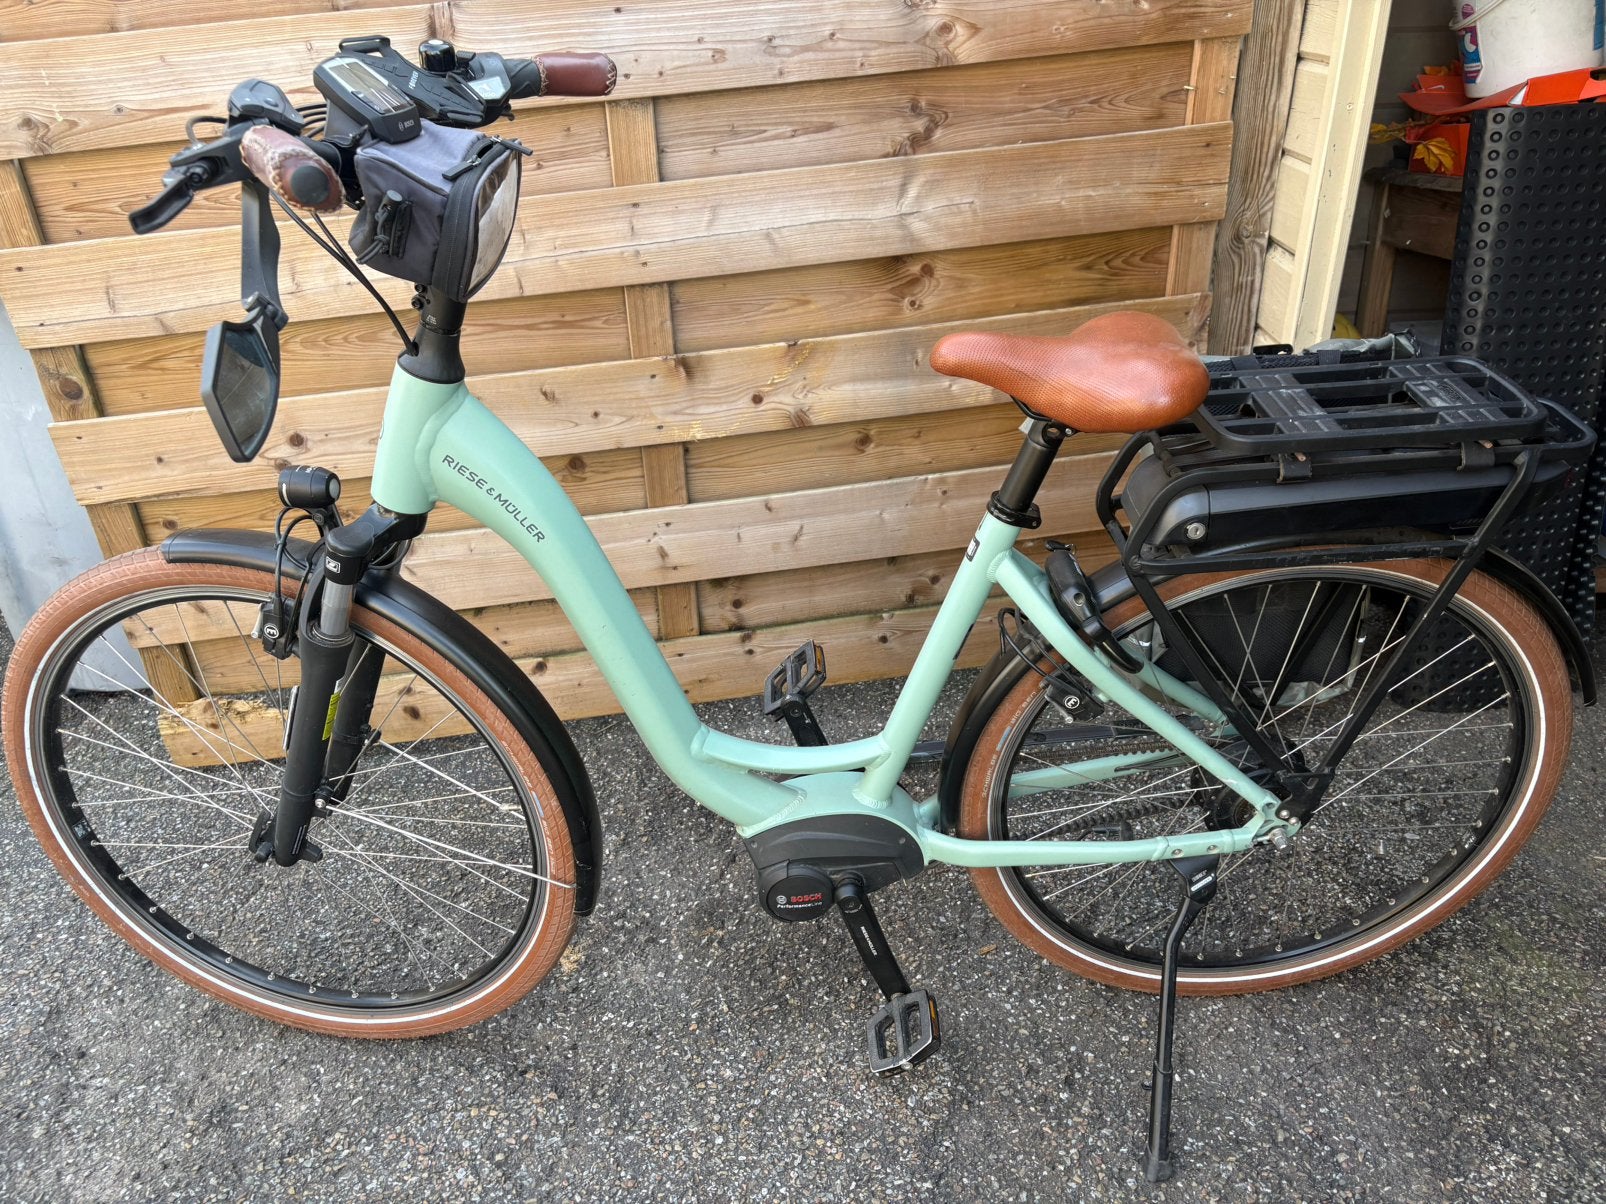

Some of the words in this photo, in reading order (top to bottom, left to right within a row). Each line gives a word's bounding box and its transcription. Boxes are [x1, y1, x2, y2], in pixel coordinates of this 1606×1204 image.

[442, 454, 488, 490] RIESE
[486, 487, 495, 496] &
[493, 493, 546, 543] MÜLLER
[791, 893, 823, 903] BOSCH
